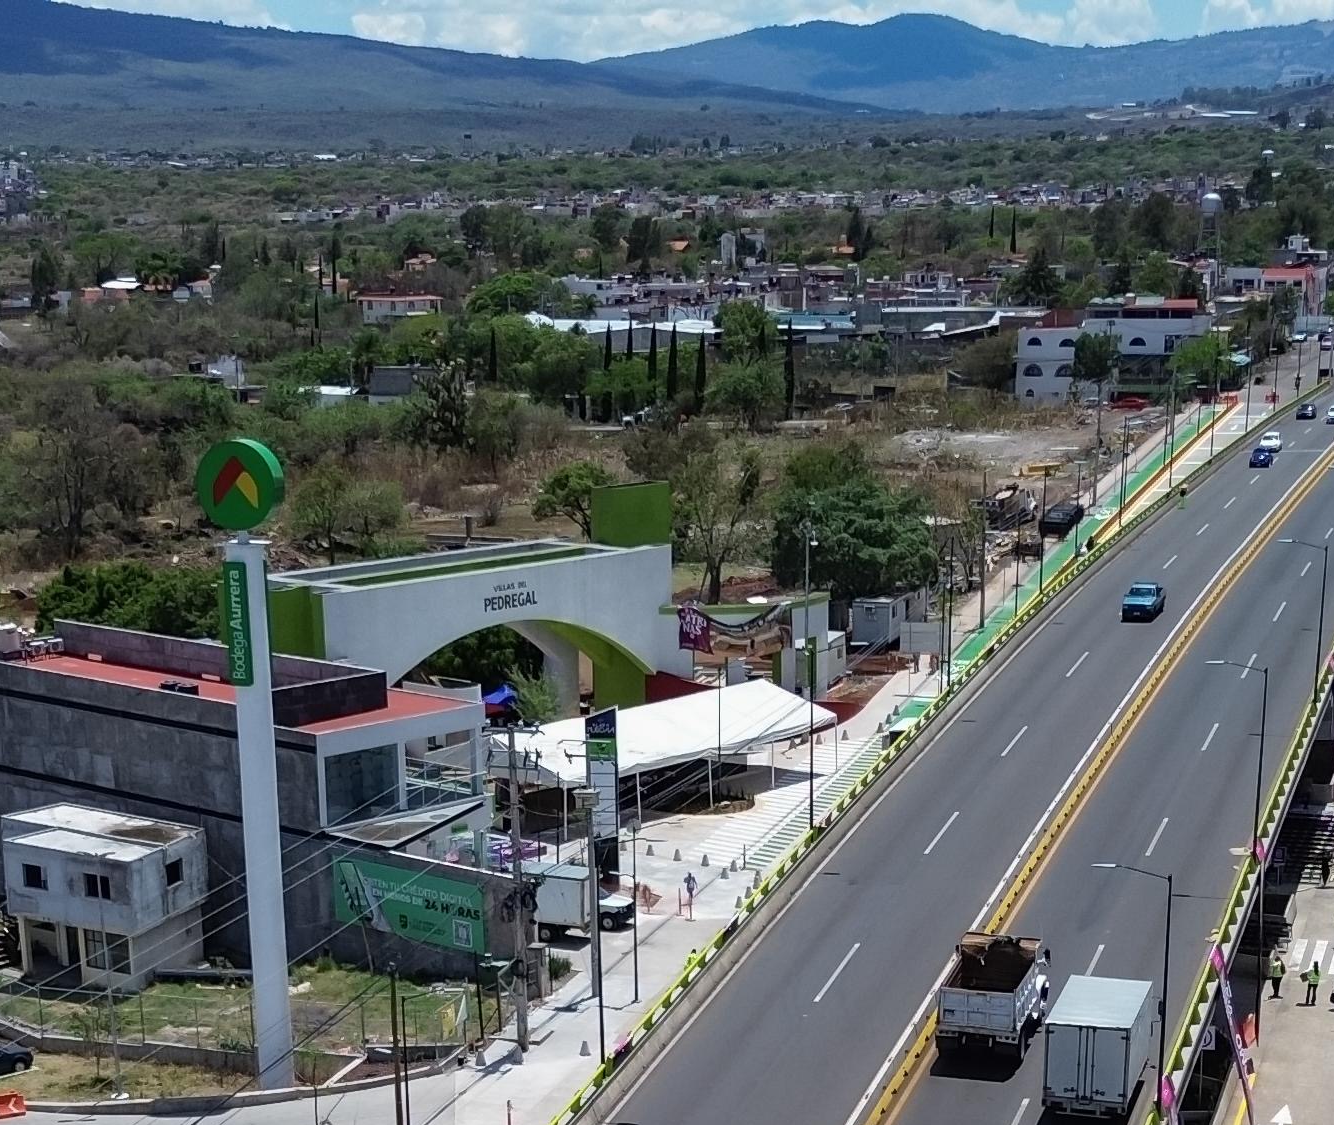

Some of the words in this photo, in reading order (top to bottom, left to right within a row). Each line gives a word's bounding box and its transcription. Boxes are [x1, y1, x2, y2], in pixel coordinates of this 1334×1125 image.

[229, 570, 243, 630] Aurrera
[484, 591, 538, 613] PEDREGAL
[230, 632, 248, 679] Bodega
